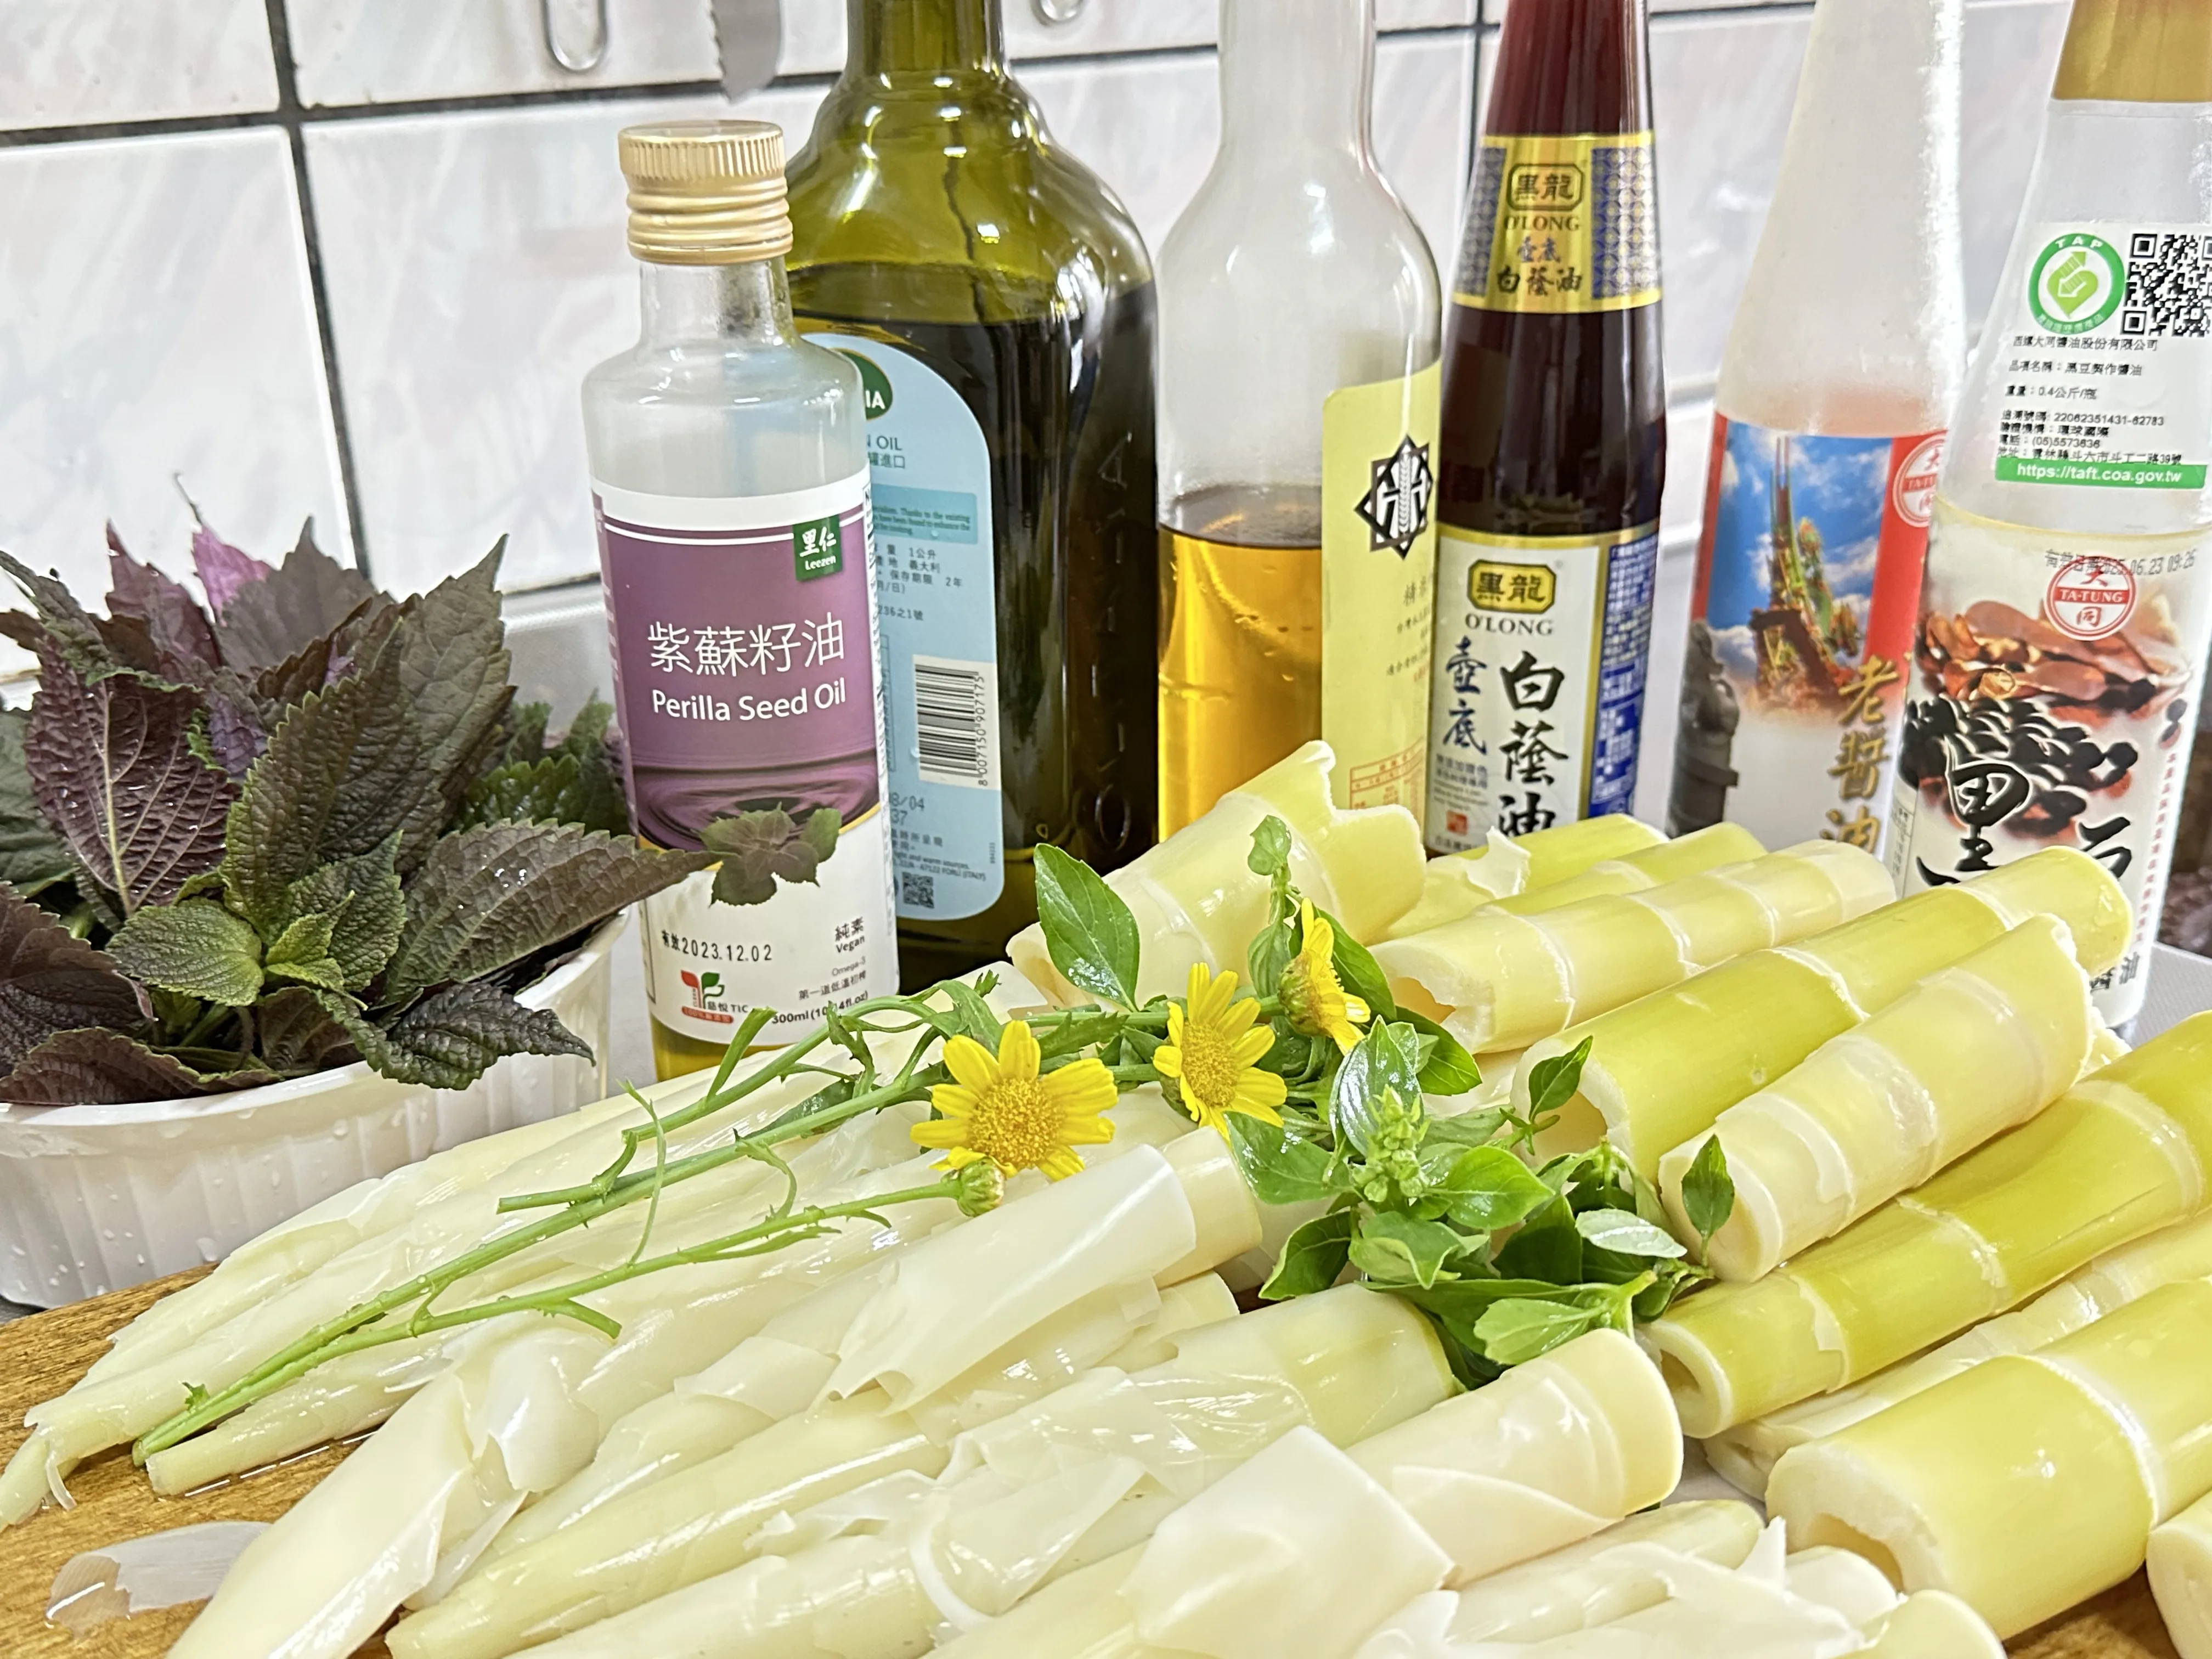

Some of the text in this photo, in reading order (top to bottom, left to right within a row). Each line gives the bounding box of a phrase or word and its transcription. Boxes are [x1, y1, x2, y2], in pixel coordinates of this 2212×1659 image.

[1515, 173, 1574, 201] 黑龍
[2055, 236, 2103, 249] TAP
[876, 435, 903, 451] OIL
[2017, 463, 2182, 483] https://taft.coa.gov.tw
[799, 527, 837, 557] 里仁
[805, 555, 836, 571] Leezen
[2080, 562, 2108, 586] 大
[1476, 572, 1546, 603] 黑龍
[2060, 589, 2123, 603] TA-TUNG
[1465, 612, 1554, 636] O'LONG
[2076, 606, 2102, 627] 同
[647, 612, 845, 677] 紫蘇籽油
[653, 678, 846, 721] Perilla Seed Oil
[1820, 654, 1900, 854] 老醬油
[836, 935, 865, 953] Vegan
[832, 956, 866, 976] Omega-3
[730, 1003, 749, 1013] TIC
